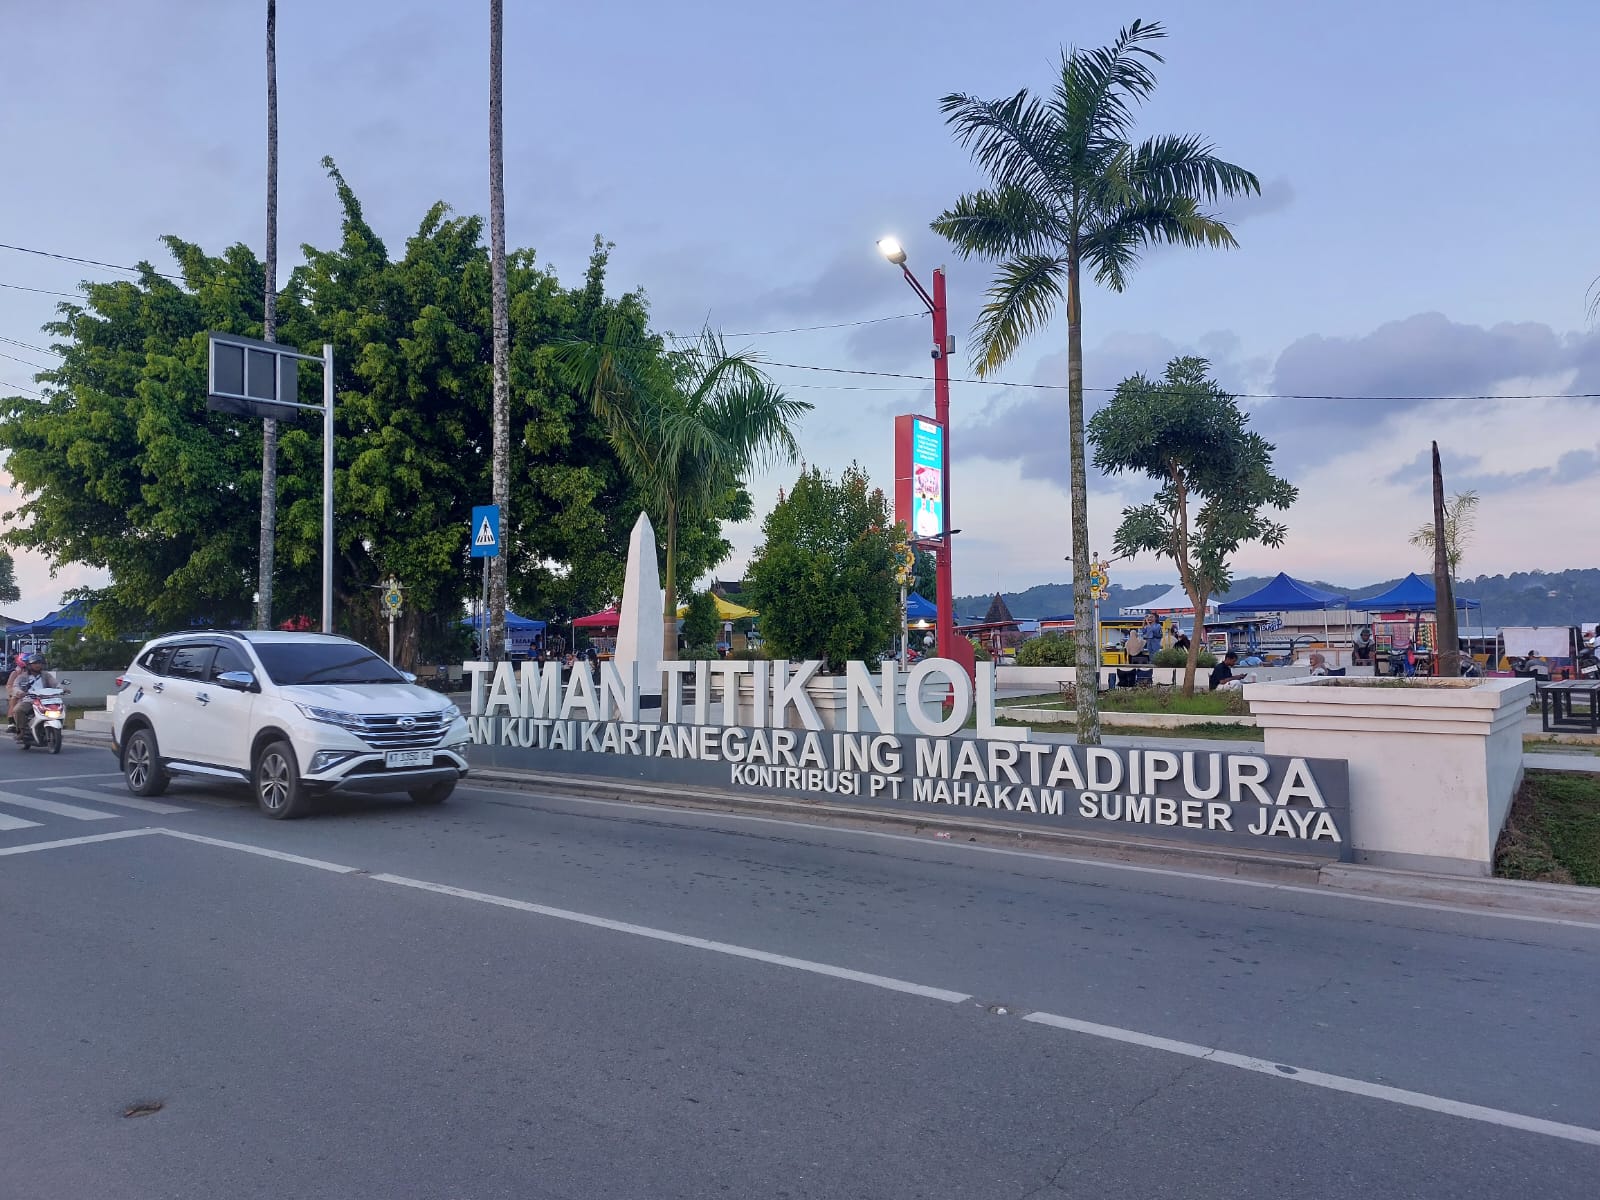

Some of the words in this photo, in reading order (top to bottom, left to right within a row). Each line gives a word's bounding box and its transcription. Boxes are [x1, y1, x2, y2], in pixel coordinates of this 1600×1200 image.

[463, 660, 639, 723] TAMAN
[657, 659, 825, 731] TITIK
[846, 657, 1032, 742] NOL
[501, 717, 577, 750] KUTAI
[581, 721, 828, 769] KARTANEGARA
[833, 733, 904, 774] ING
[915, 738, 1328, 808] MARTADIPURA
[731, 763, 861, 796] KONTRIBUSI
[870, 774, 904, 799] PT
[912, 777, 1065, 816] MAHAKAM
[1078, 791, 1235, 832] SUMBER
[1247, 807, 1343, 843] JAYA
